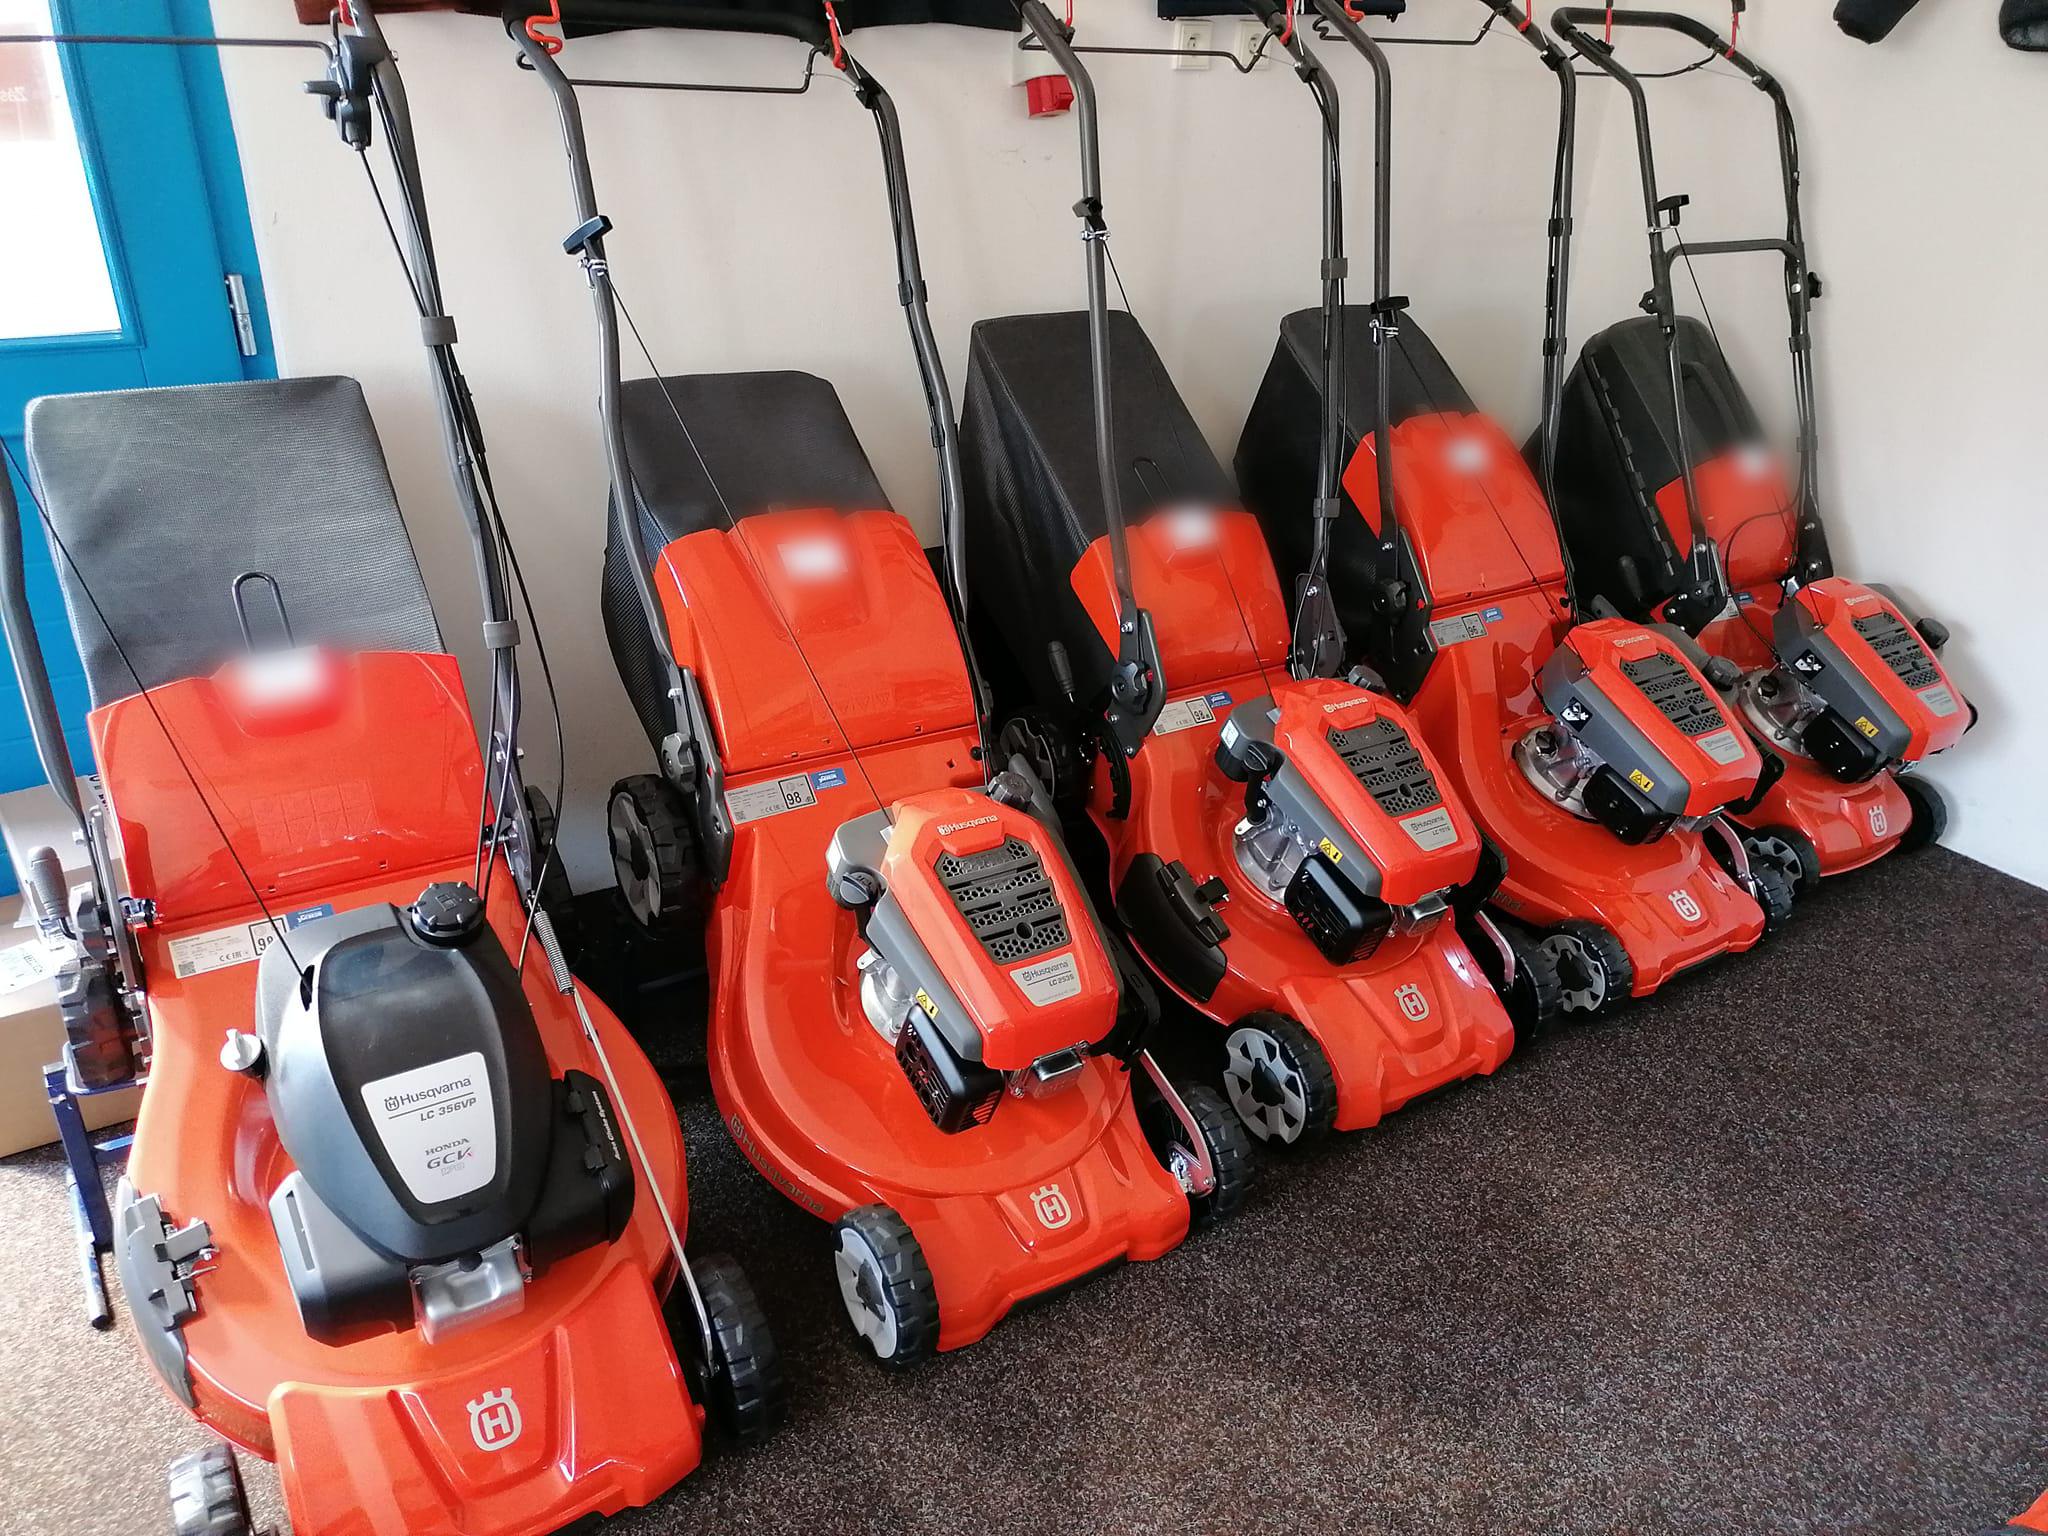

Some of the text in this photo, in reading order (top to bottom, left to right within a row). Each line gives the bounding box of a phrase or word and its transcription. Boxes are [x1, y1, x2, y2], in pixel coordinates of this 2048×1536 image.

[786, 791, 802, 806] 98
[949, 815, 999, 833] Husqvarna
[1030, 961, 1070, 978] Husqvarna
[400, 1077, 472, 1107] Husqvarna
[420, 1097, 477, 1122] LC 356VP
[425, 1137, 470, 1156] HONDA
[743, 1133, 825, 1214] Husqvarna
